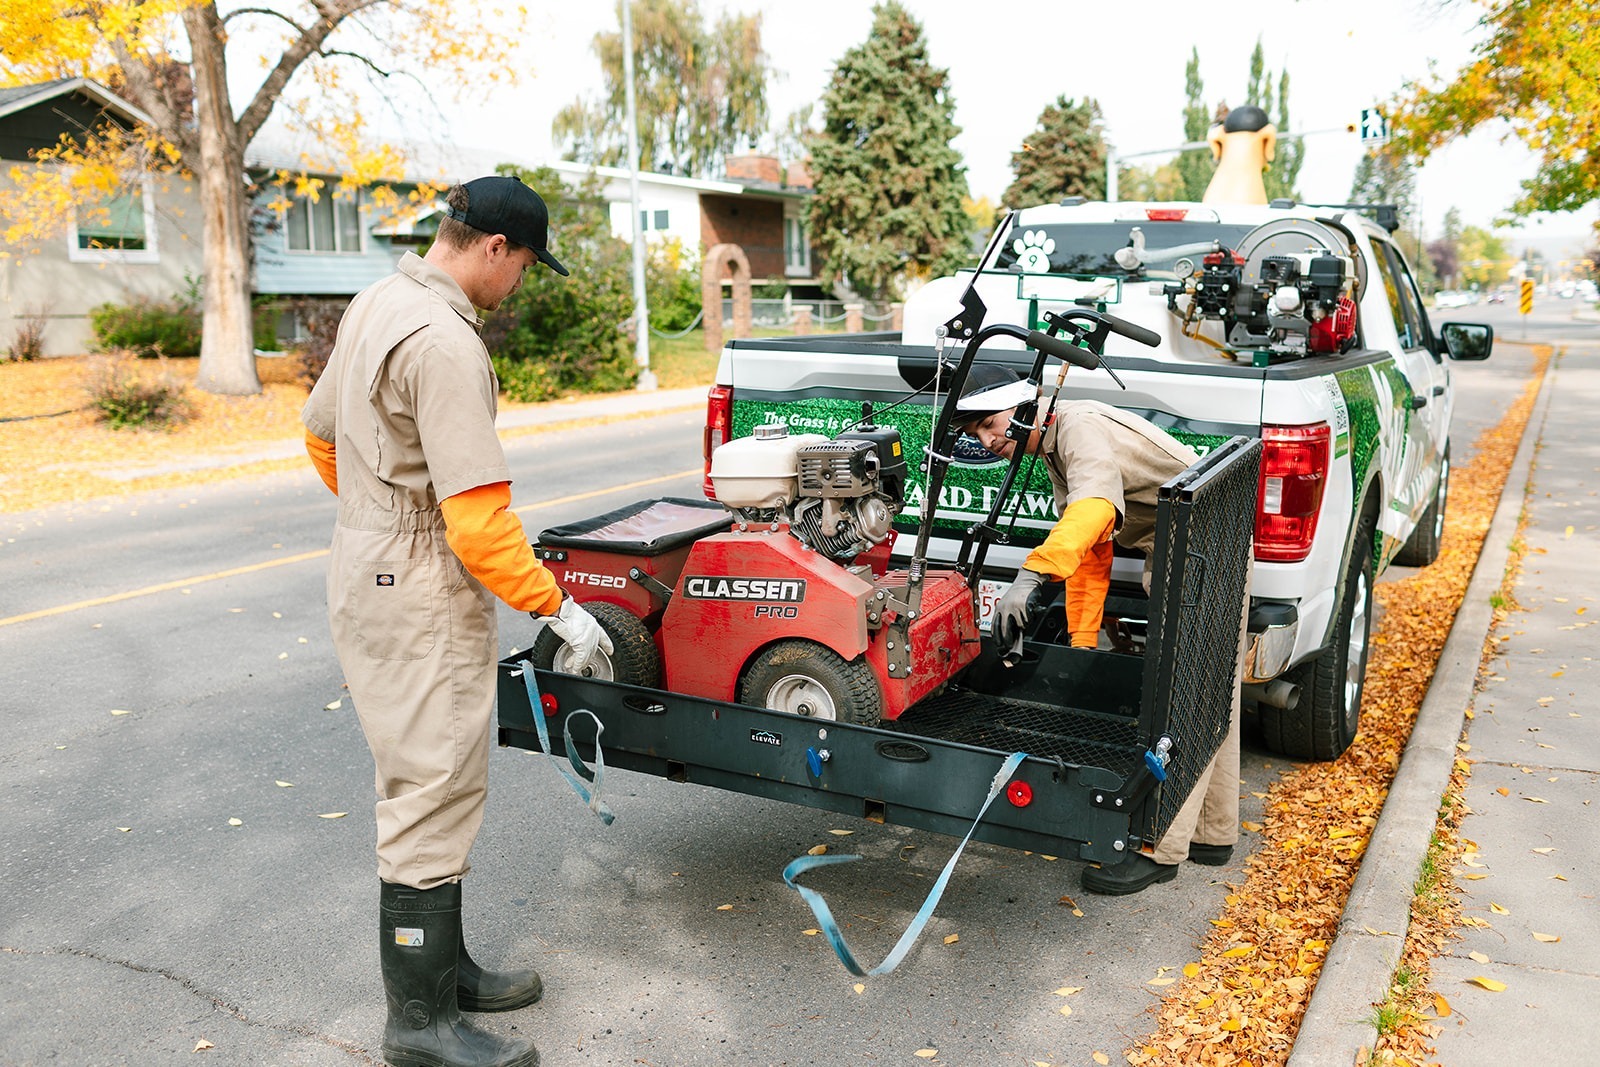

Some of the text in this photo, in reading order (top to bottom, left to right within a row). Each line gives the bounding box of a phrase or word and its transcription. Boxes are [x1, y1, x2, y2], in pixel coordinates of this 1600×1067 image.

[1029, 255, 1038, 267] 9
[764, 411, 787, 425] The
[789, 415, 824, 429] Grass
[827, 418, 839, 430] Is
[563, 570, 627, 589] HTS20
[687, 578, 799, 600] CLASSEN
[754, 605, 799, 619] PRO
[751, 734, 781, 746] ELEVATE
